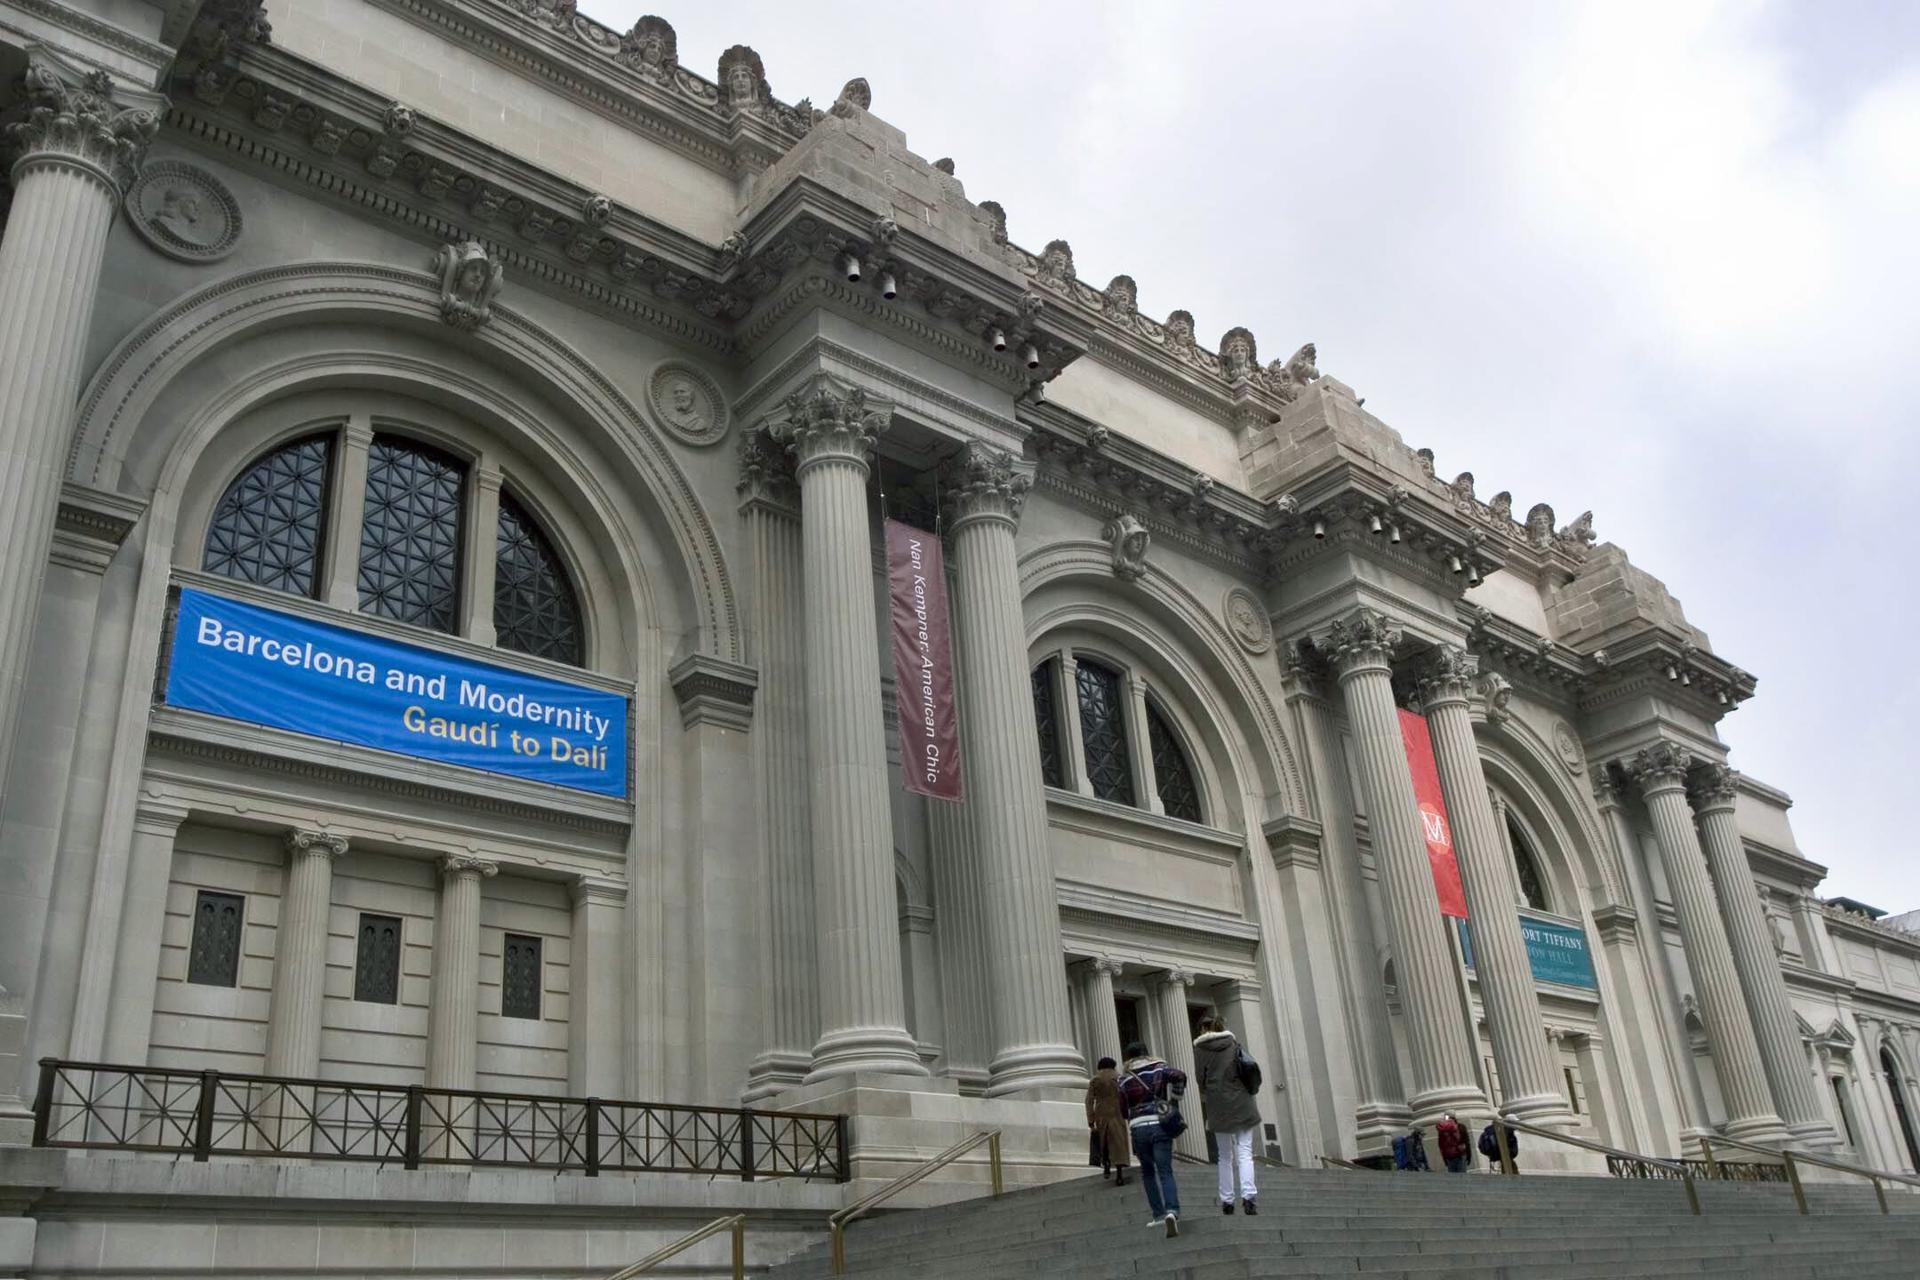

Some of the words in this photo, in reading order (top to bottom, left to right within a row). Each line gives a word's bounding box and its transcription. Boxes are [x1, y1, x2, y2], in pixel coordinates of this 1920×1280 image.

[909, 538, 923, 571] Nan
[914, 574, 930, 653] Kempner:
[197, 617, 376, 685] Barcelona
[386, 669, 446, 701] and
[459, 680, 610, 741] Modernity
[921, 654, 937, 738] American
[403, 706, 499, 748] Gaudí
[510, 730, 540, 757] to
[551, 737, 607, 771] Dalí
[926, 743, 941, 783] Chic
[1522, 927, 1540, 942] ORT
[1543, 932, 1582, 951] TIFFANY
